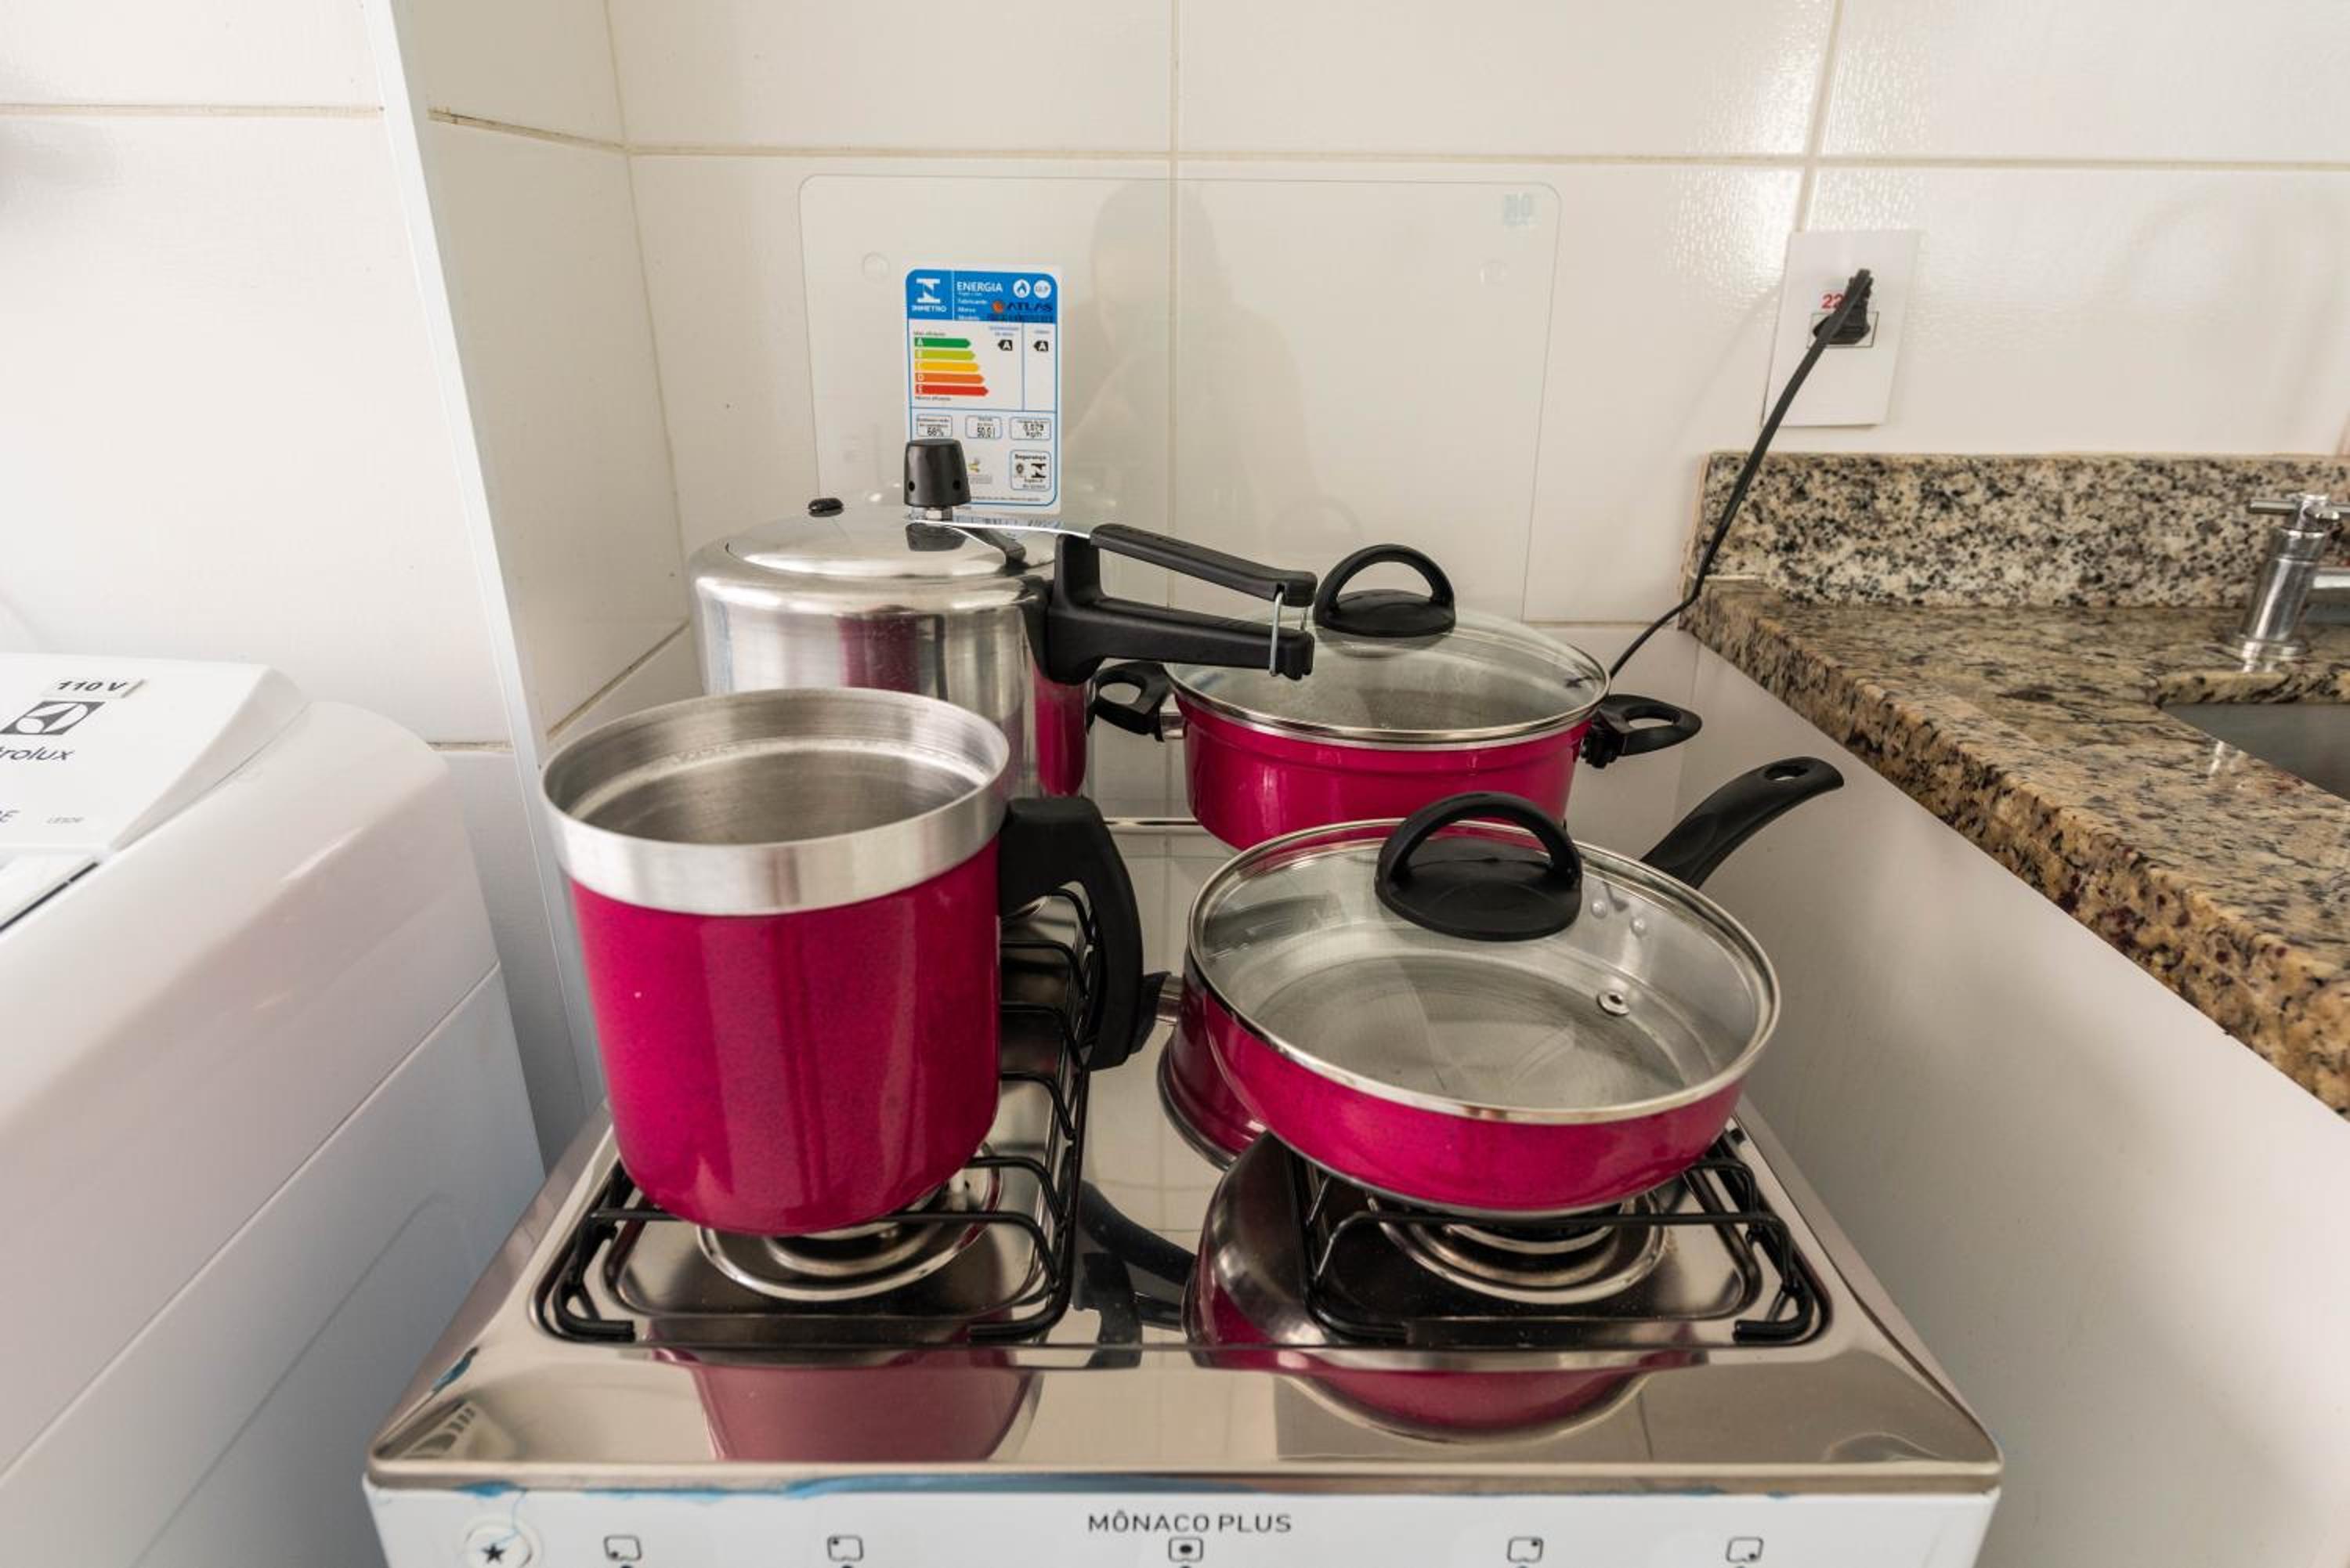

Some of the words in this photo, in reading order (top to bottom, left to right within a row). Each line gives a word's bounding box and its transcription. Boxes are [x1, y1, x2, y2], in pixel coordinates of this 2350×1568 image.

[956, 281, 1003, 292] ENERGIA
[1007, 302, 1054, 313] ATLAS
[57, 681, 103, 691] 110
[1088, 1508, 1210, 1533] MÔNACO
[1218, 1513, 1292, 1533] PLUS
